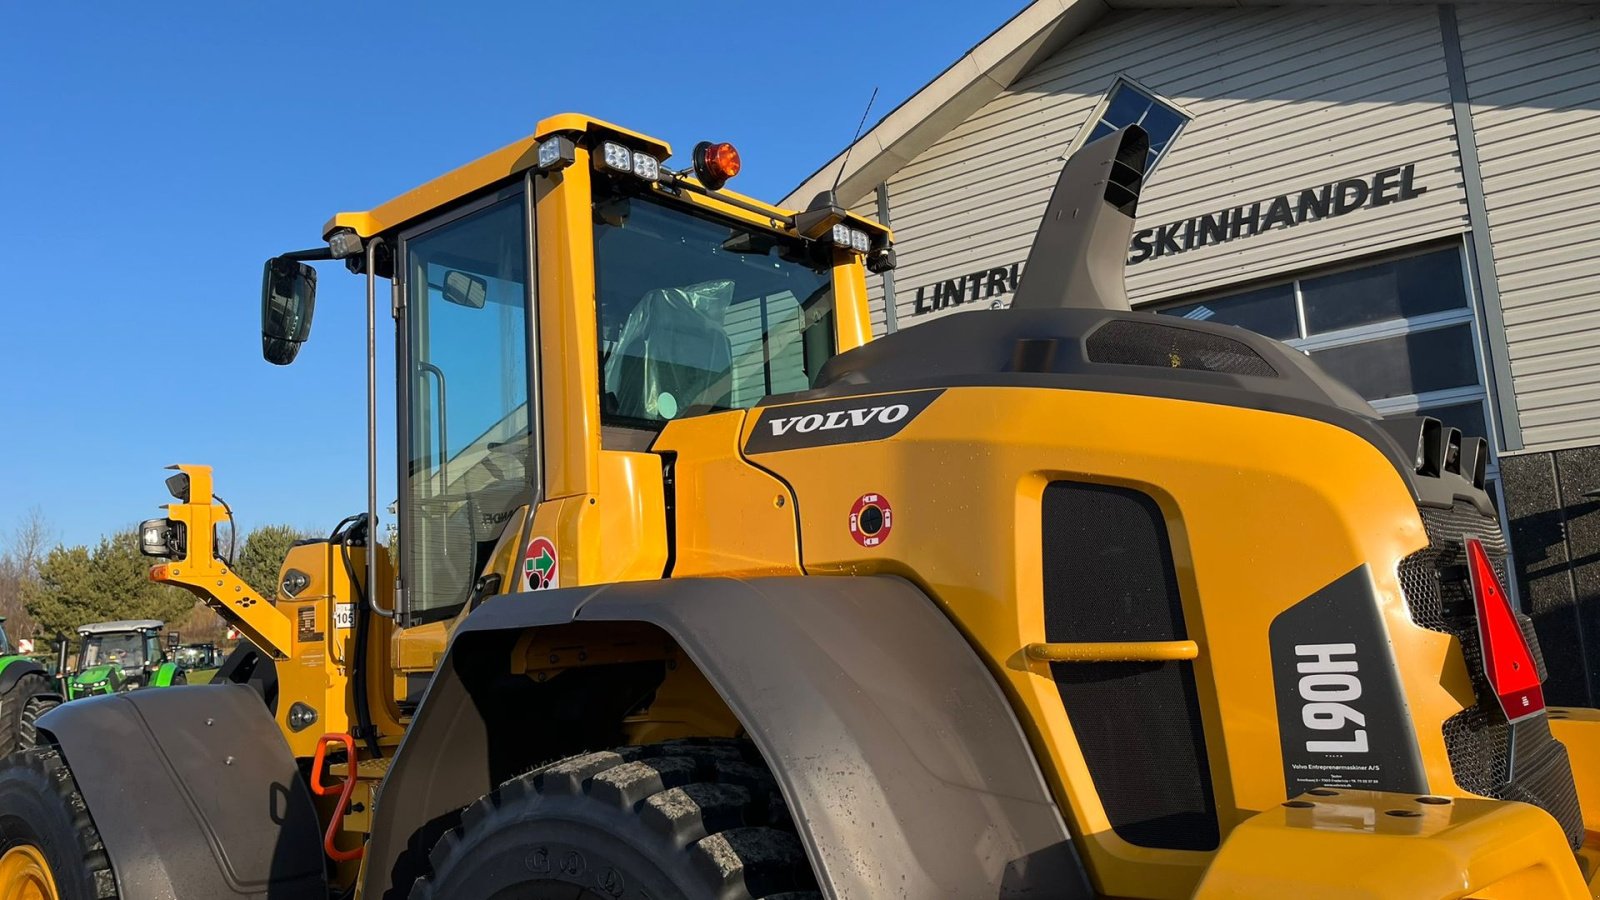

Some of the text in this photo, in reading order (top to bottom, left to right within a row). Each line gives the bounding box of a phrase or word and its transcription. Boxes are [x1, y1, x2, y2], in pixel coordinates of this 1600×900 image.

[1126, 164, 1428, 266] SKINHANDEL
[768, 404, 910, 436] VOLVO
[1294, 643, 1369, 753] L90H
